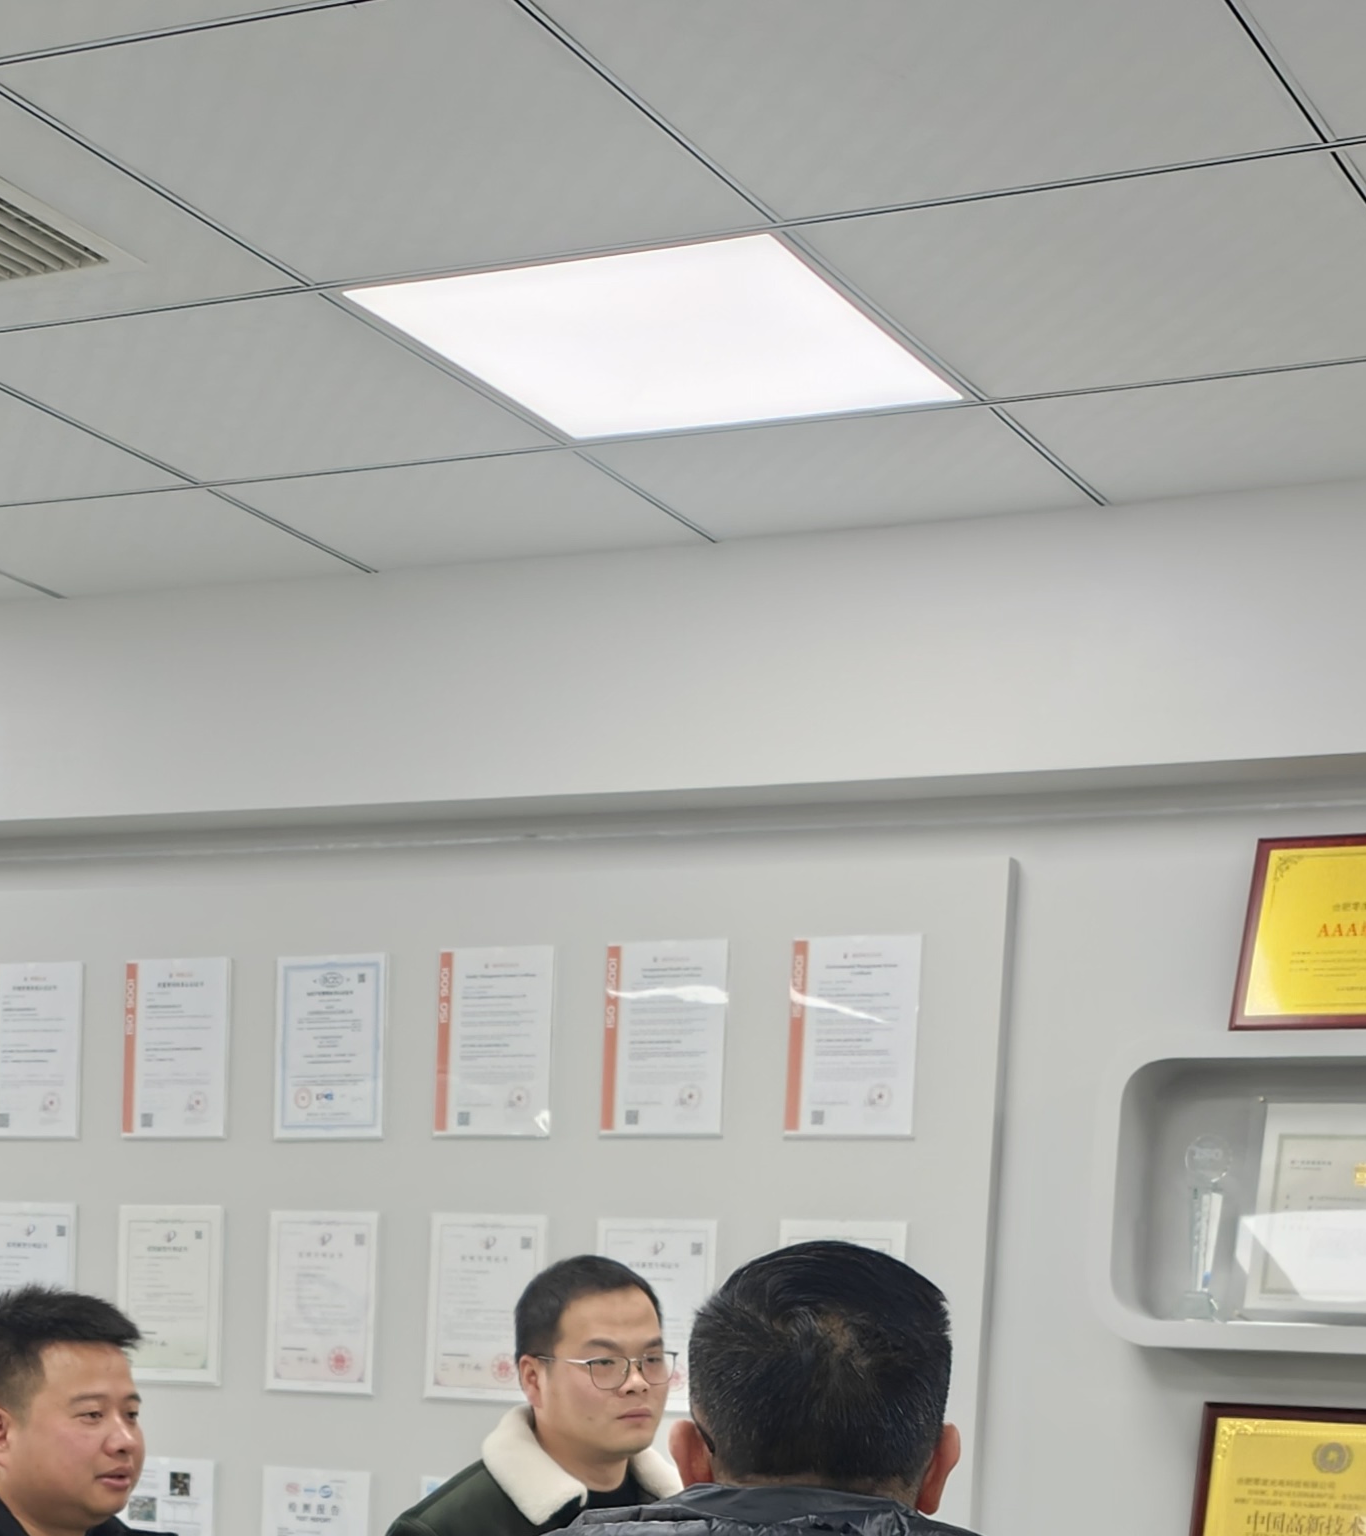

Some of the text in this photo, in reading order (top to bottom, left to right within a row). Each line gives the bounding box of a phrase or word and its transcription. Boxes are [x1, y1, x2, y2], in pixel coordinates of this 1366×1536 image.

[125, 978, 135, 1008] 9001
[439, 967, 450, 1024] ISO 9001
[605, 1005, 616, 1029] ISO
